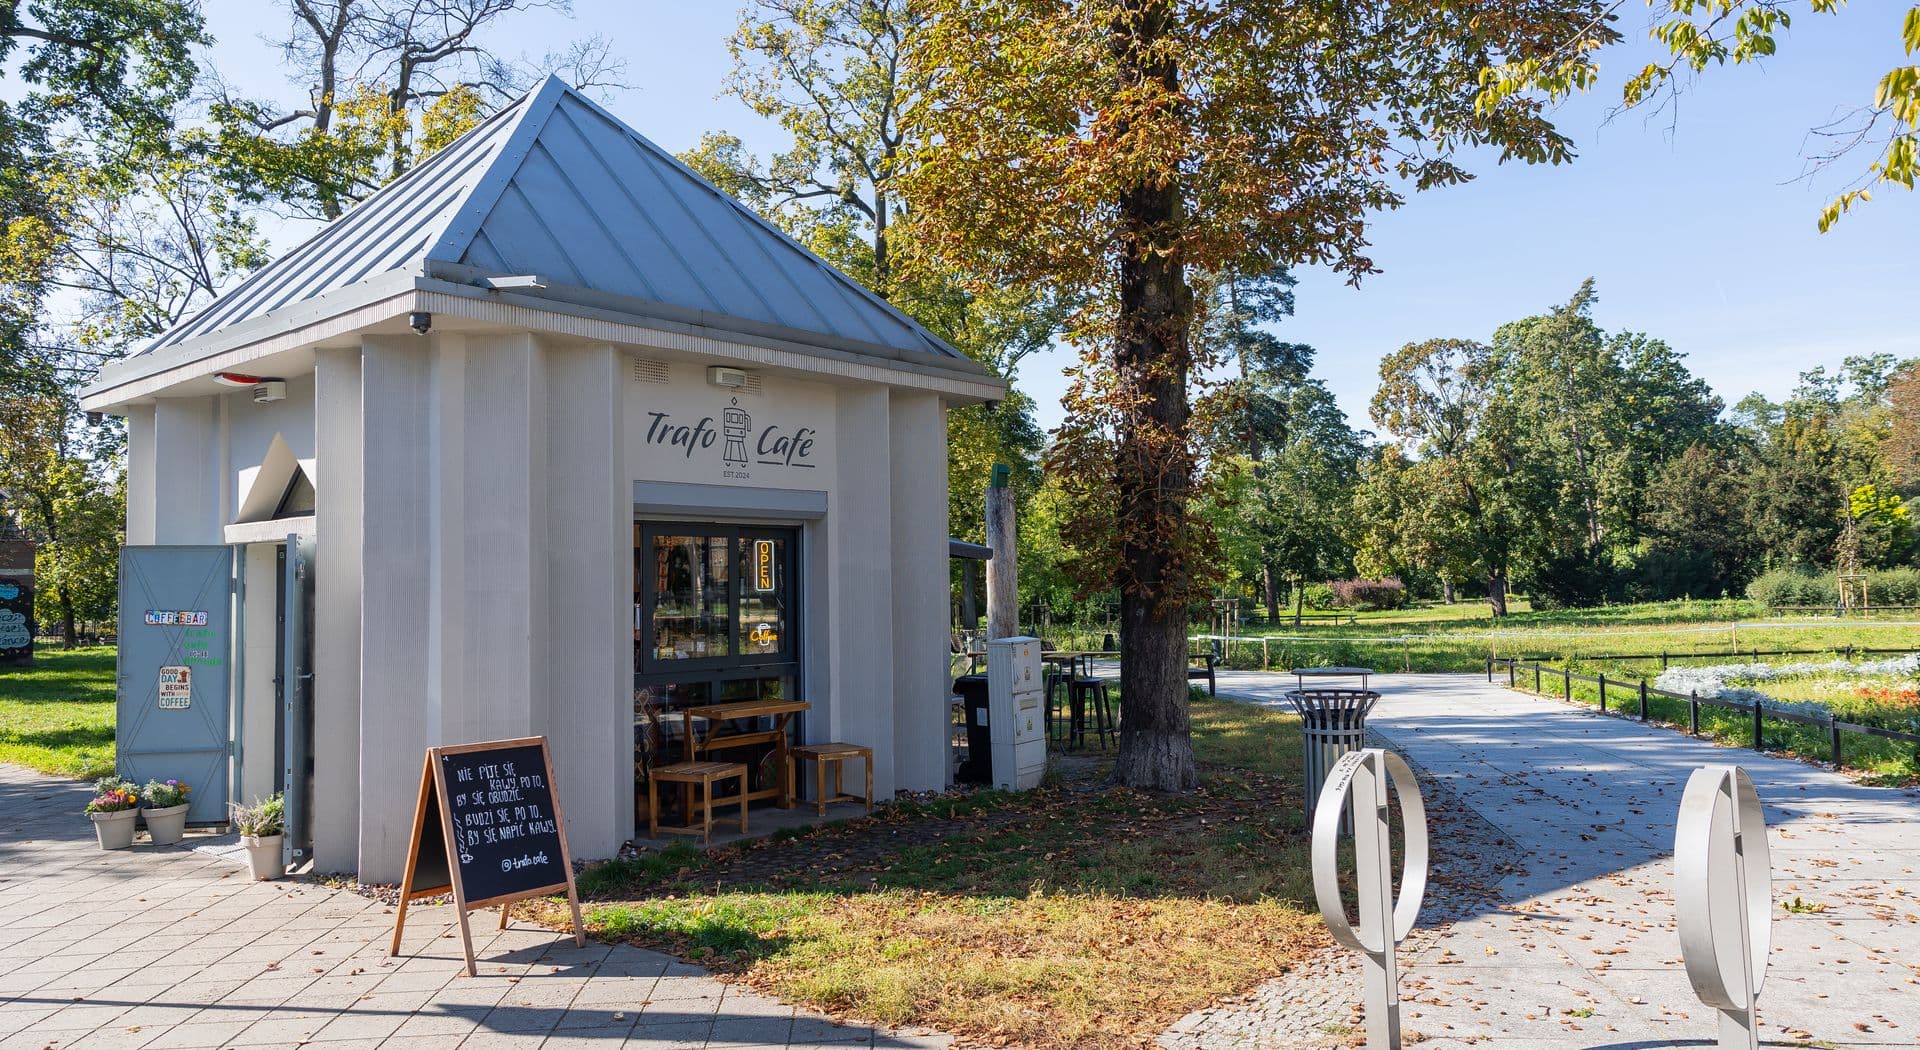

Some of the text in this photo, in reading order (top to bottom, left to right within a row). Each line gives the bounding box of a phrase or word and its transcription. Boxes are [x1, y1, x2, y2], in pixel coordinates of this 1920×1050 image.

[646, 411, 816, 466] Trafo Café
[760, 542, 770, 589] OPEN
[160, 697, 189, 707] COFFEE
[457, 767, 474, 783] NIE
[478, 763, 500, 780] PIJE
[489, 777, 516, 791] KAWY
[520, 776, 531, 789] PO
[456, 793, 467, 807] BY
[471, 790, 486, 806] SIĘ
[465, 809, 494, 827] BUDZI
[496, 807, 511, 824] SIĘ
[514, 806, 526, 821] PO
[467, 830, 480, 847] BY
[498, 821, 526, 841] NAPIĆ
